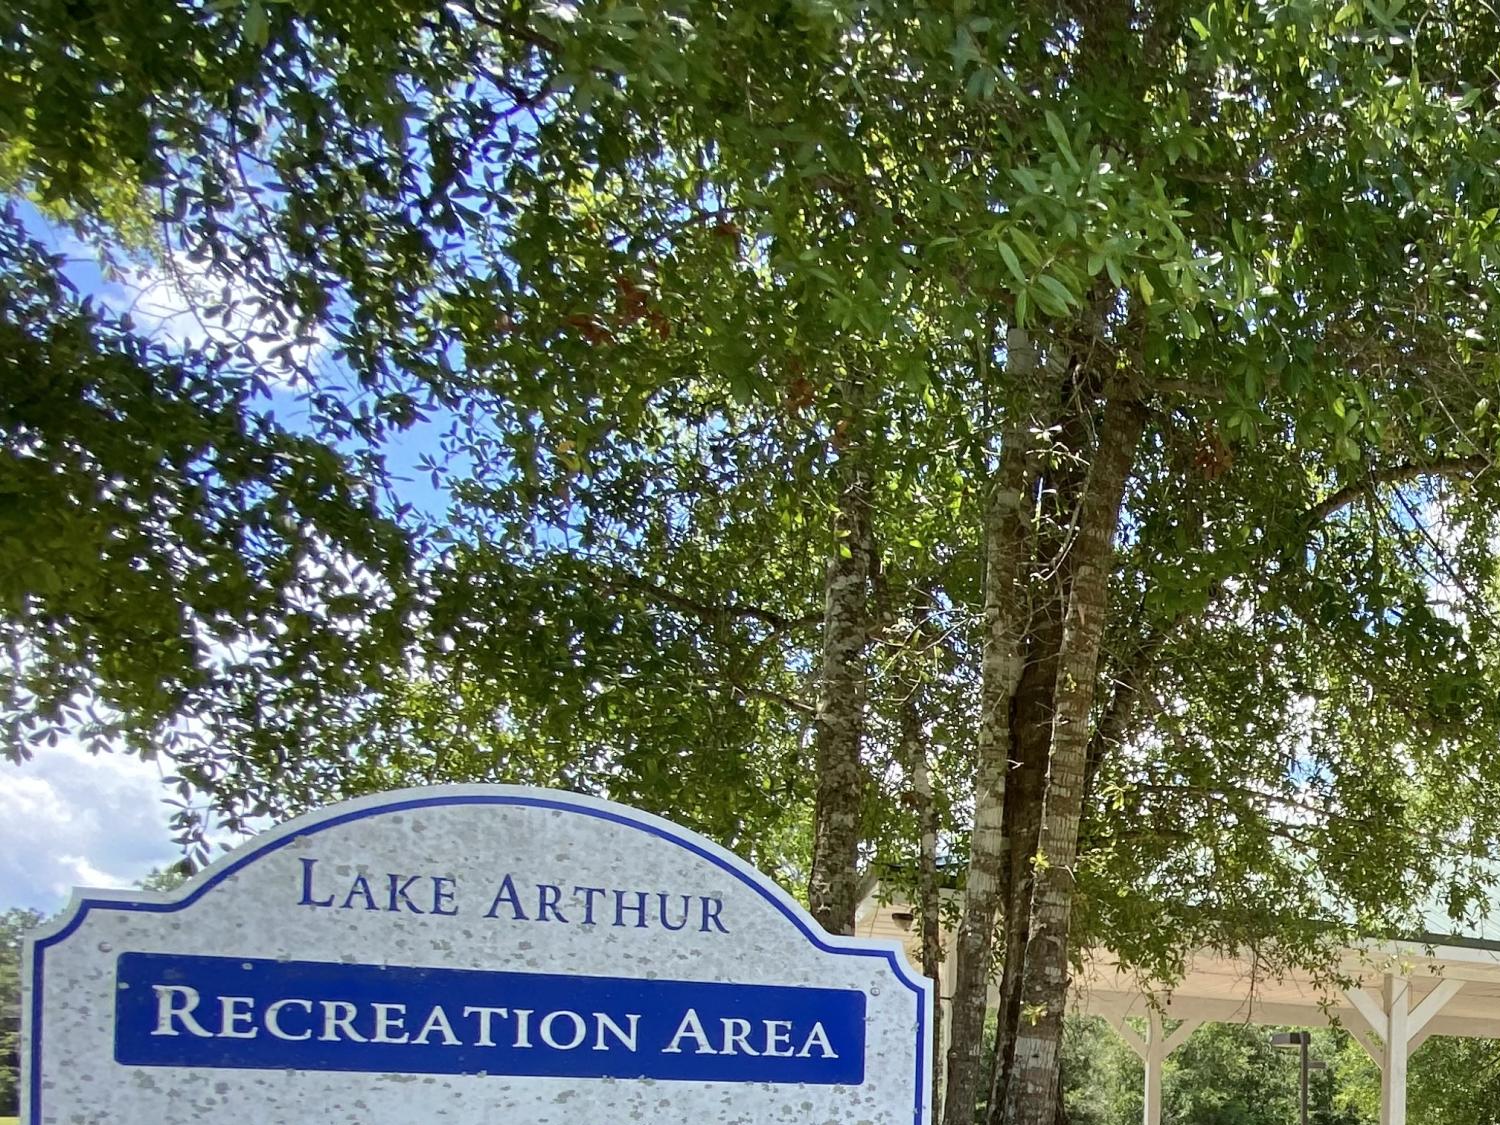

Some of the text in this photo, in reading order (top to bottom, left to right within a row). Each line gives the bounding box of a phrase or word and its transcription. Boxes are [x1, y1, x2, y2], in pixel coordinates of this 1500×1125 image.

[297, 857, 731, 935] LAKE ARTHUR
[150, 984, 839, 1059] RECREATION AREA
